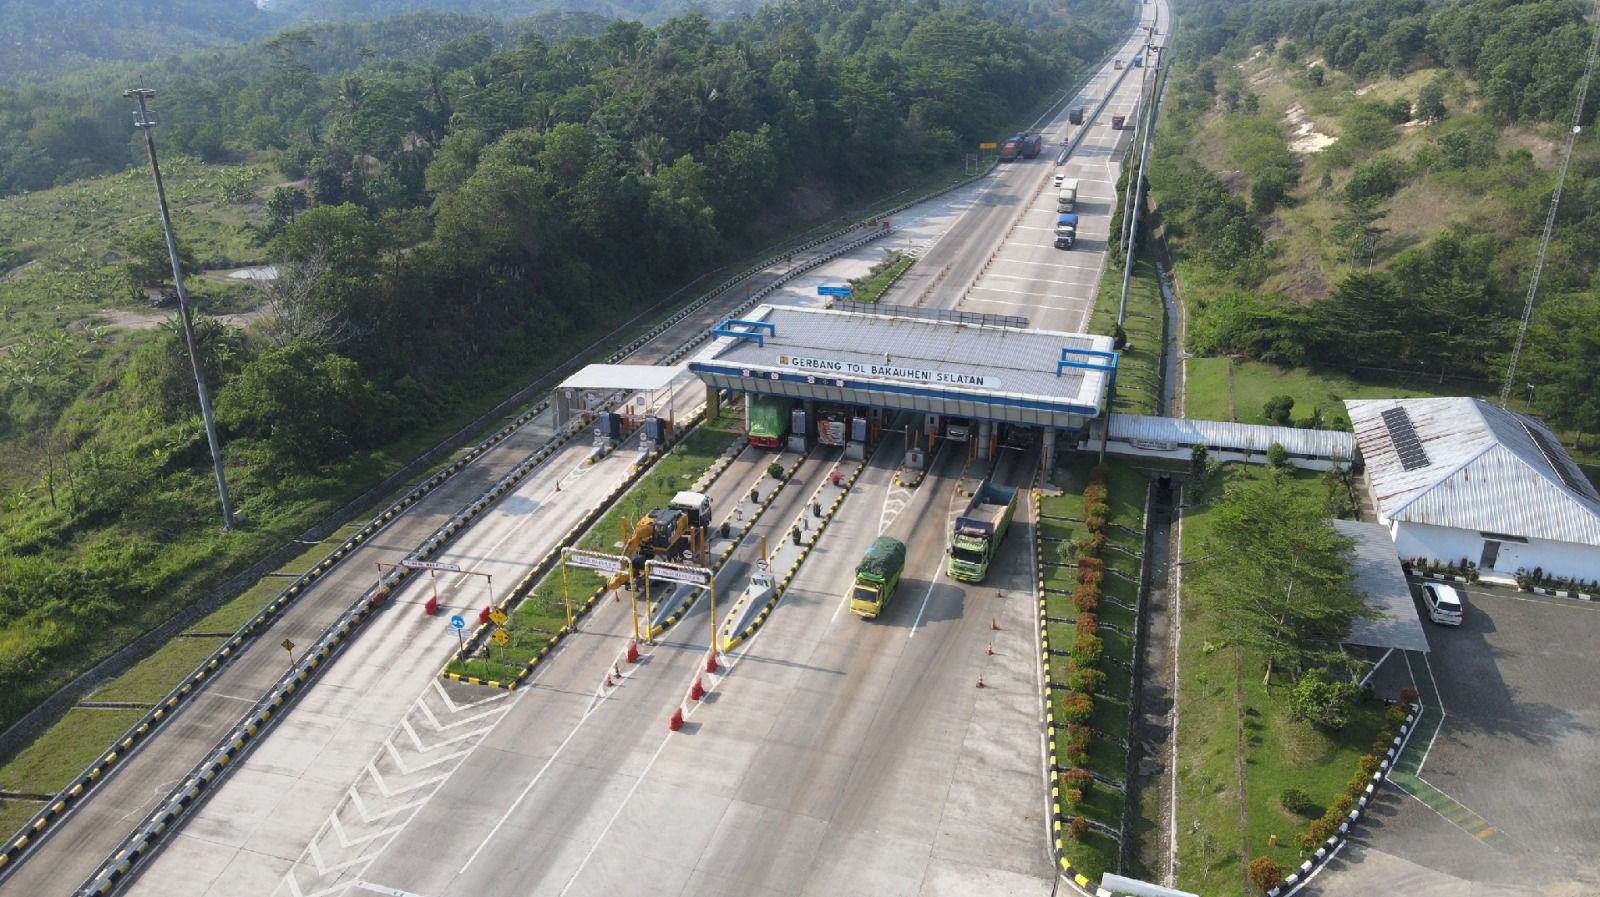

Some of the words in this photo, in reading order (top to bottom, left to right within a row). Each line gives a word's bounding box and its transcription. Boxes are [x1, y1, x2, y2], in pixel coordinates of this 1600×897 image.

[792, 357, 842, 371] GERBANG
[846, 363, 866, 373] TOL
[871, 366, 932, 380] BAKAUHENI
[936, 373, 984, 386] SELATAN
